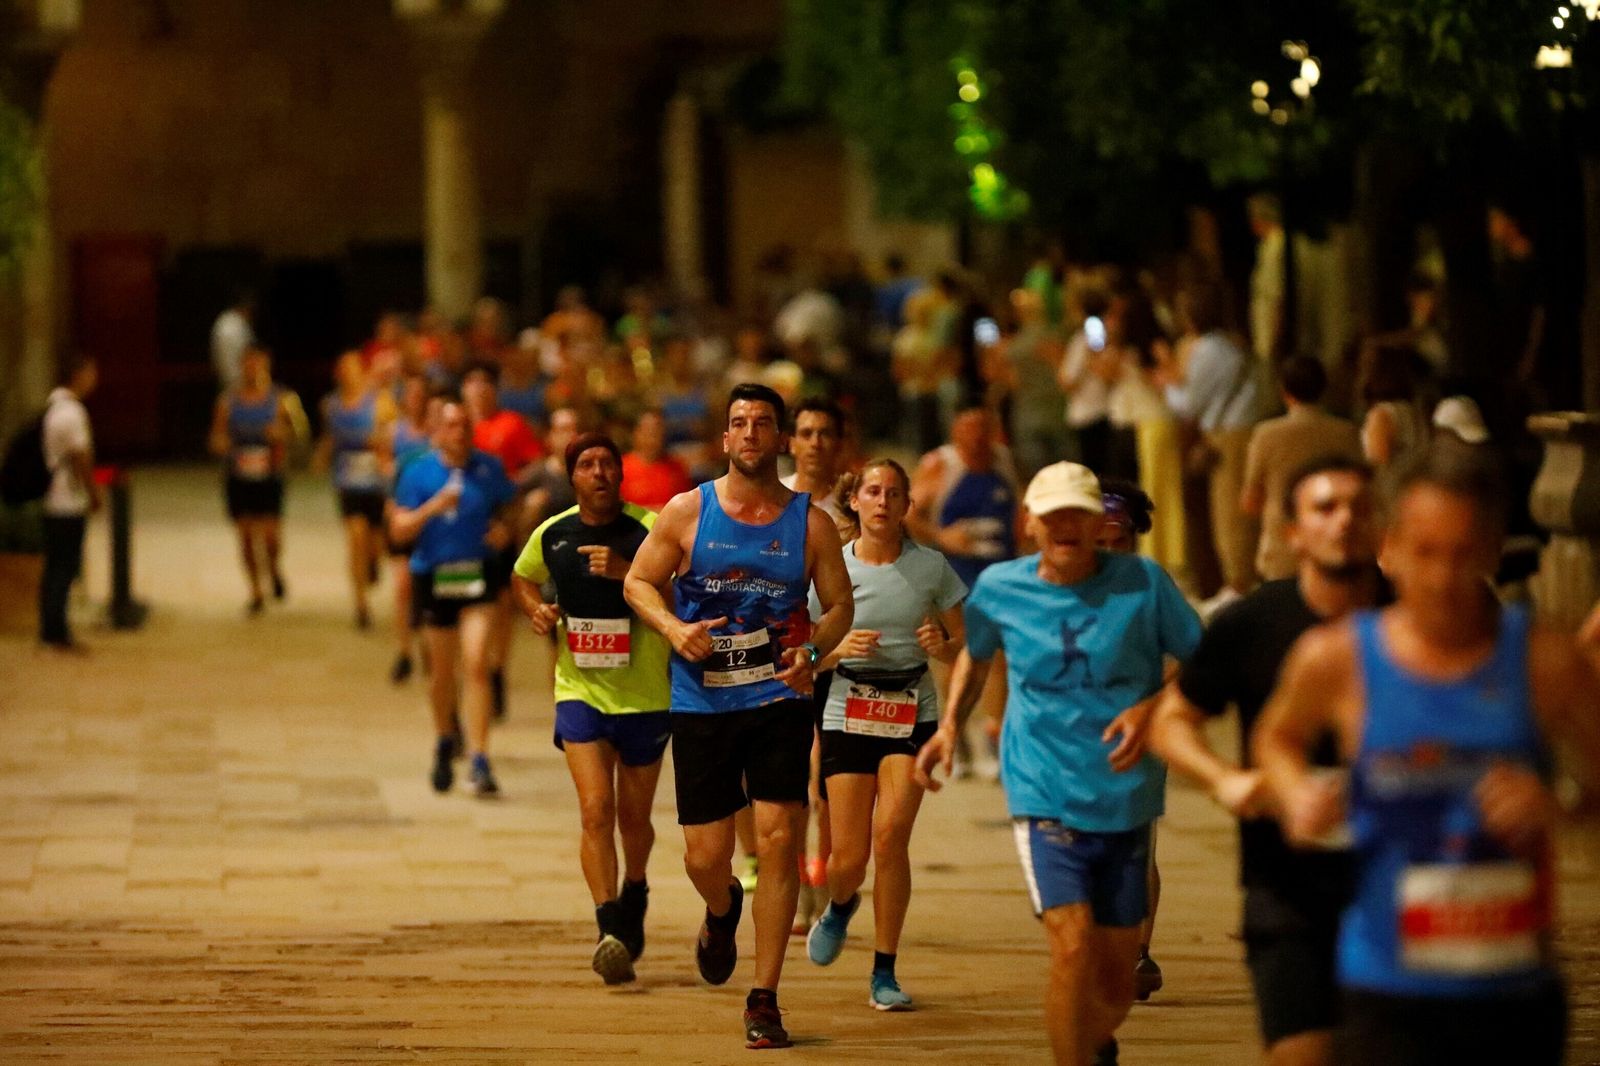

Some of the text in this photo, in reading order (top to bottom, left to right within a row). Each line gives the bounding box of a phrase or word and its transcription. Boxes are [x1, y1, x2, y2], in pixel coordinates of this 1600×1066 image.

[704, 578, 720, 593] 20
[752, 577, 787, 591] NOCTURNA
[580, 621, 593, 631] 20
[576, 634, 616, 649] 1512
[719, 638, 732, 649] 20
[726, 650, 747, 667] 12
[867, 688, 881, 698] 20
[865, 701, 897, 718] 140
